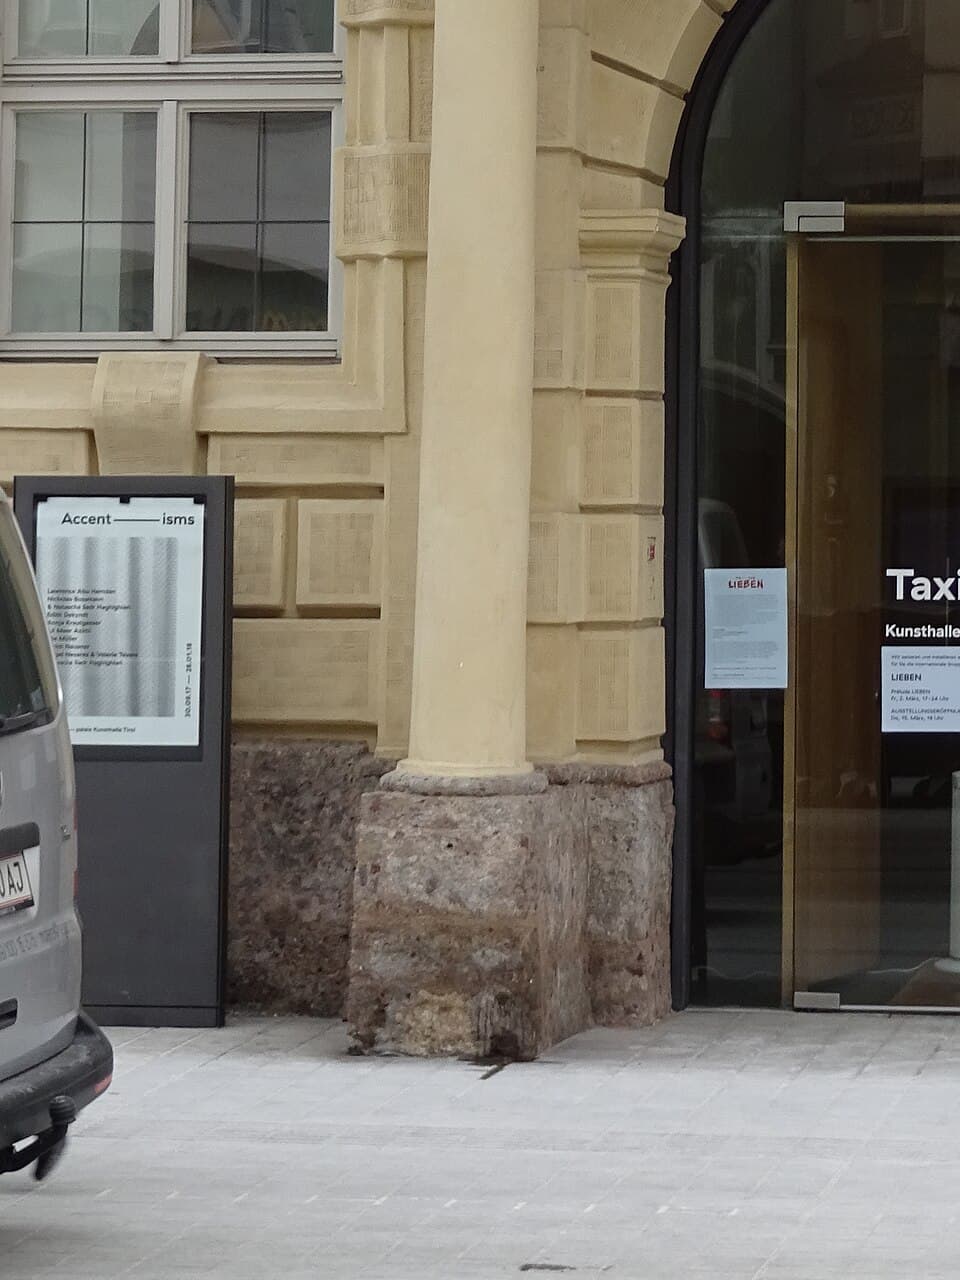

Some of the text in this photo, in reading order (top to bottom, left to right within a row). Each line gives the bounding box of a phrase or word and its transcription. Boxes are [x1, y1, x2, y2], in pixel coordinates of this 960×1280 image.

[61, 512, 195, 525] Accent isms
[728, 580, 764, 589] LIEBEN
[885, 624, 960, 638] Kunsthalle
[891, 673, 922, 681] LIEBEN
